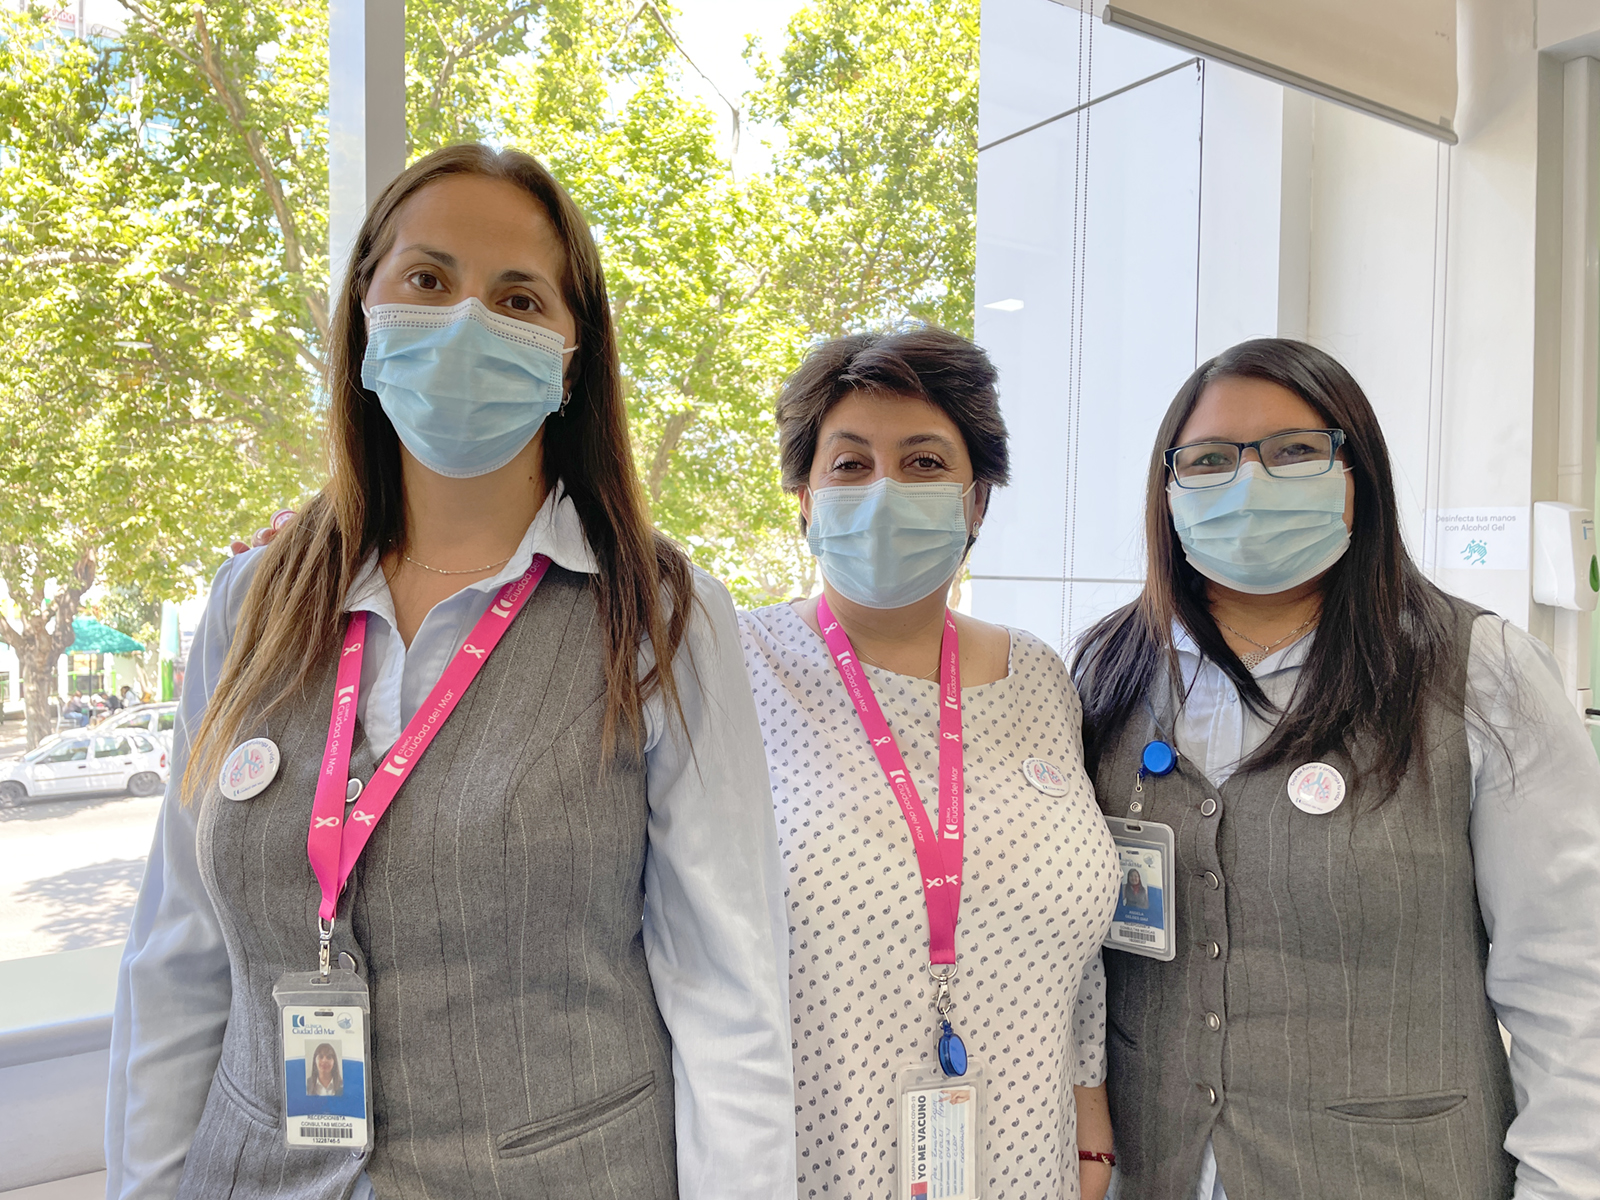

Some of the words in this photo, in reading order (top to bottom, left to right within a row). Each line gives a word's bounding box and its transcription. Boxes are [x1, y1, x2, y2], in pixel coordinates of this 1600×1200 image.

[509, 572, 532, 602] Ciudad
[530, 559, 542, 573] del
[842, 665, 858, 688] Ciudad
[853, 688, 863, 699] del
[858, 699, 869, 712] Mar
[333, 705, 345, 738] Ciudad
[404, 724, 431, 758] Ciudad
[428, 708, 442, 724] del
[438, 688, 454, 708] Mar
[330, 740, 339, 756] del
[326, 757, 336, 776] Mar
[1323, 767, 1340, 784] prolonga
[896, 784, 914, 810] Ciudad
[909, 811, 920, 824] del
[914, 826, 925, 842] Mar
[918, 1095, 926, 1142] VACUNO
[918, 1144, 926, 1161] ME
[918, 1164, 926, 1180] YO
